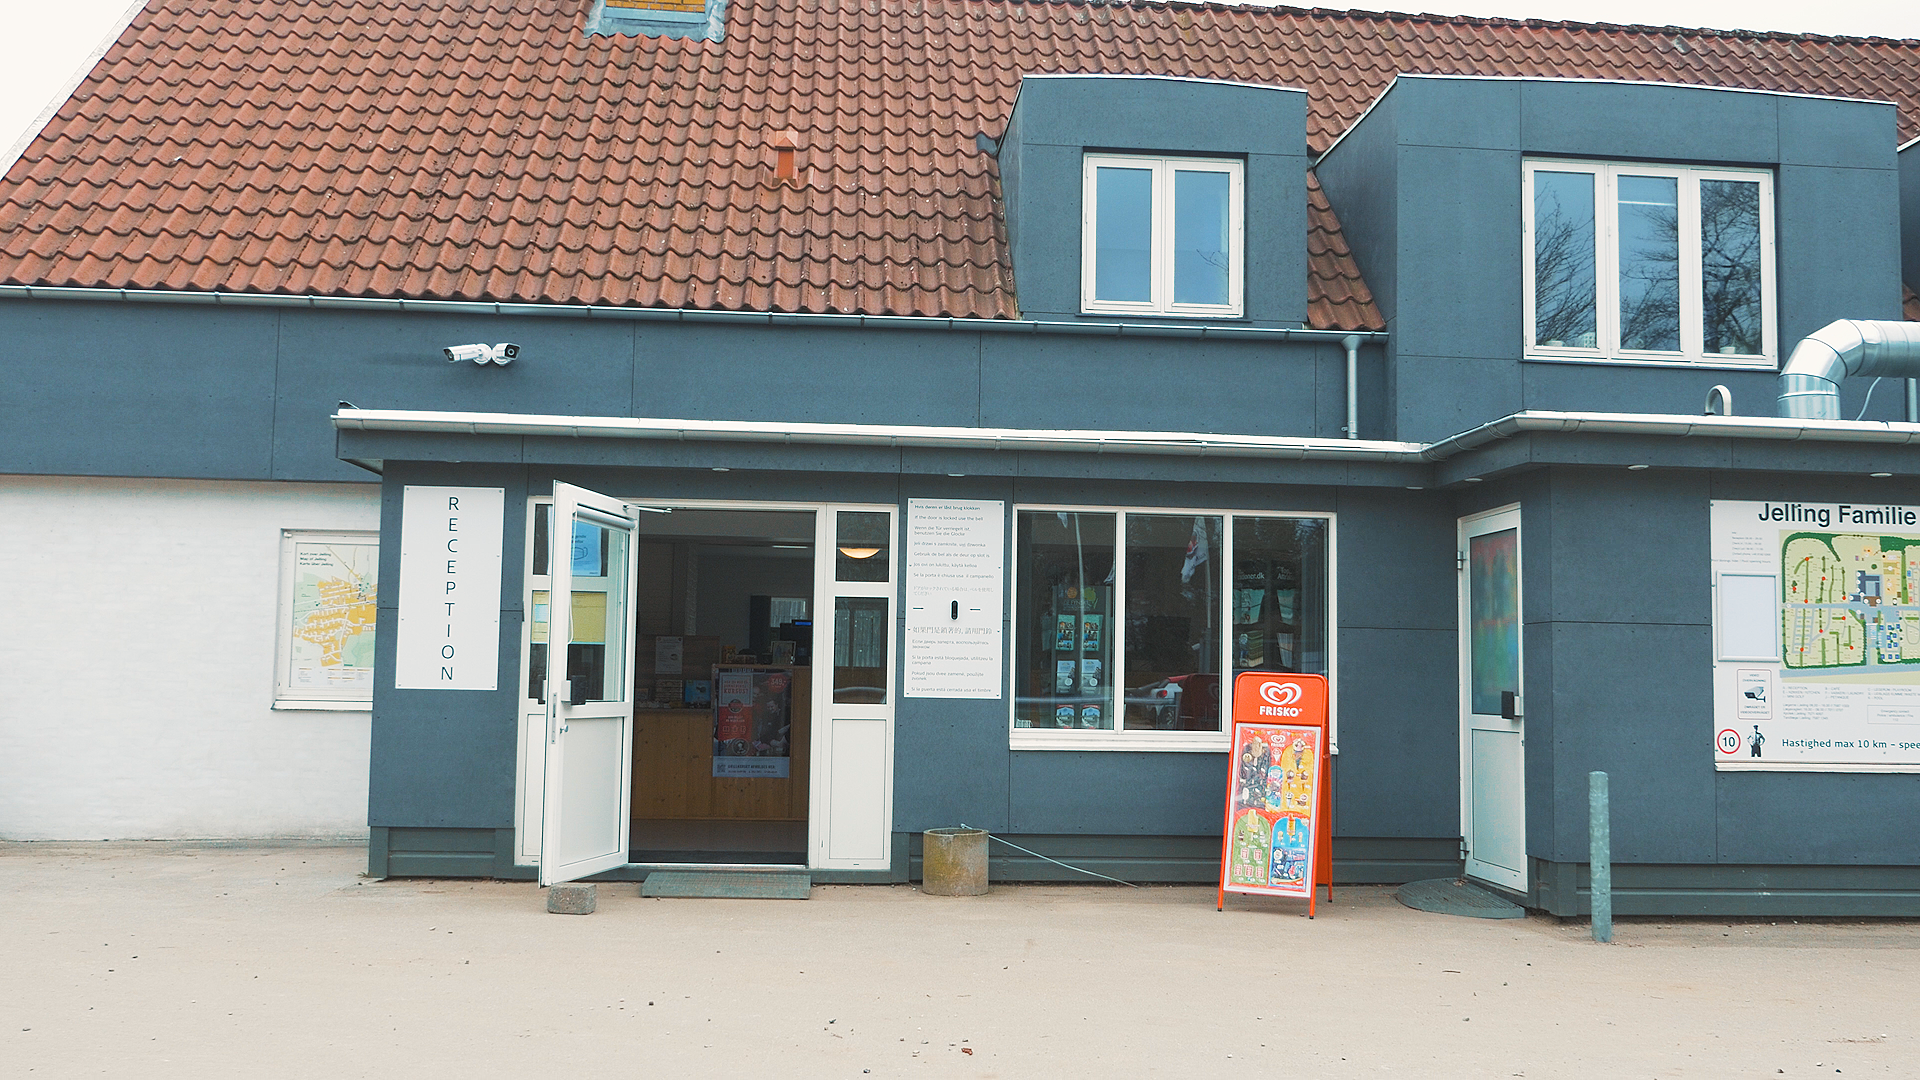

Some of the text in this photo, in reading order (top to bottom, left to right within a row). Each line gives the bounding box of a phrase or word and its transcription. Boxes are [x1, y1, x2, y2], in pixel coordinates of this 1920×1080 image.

[1758, 502, 1916, 528] Jelling Familie
[441, 496, 460, 680] RECEPTION
[1259, 706, 1299, 717] FRISKO
[1722, 737, 1735, 747] 10
[1782, 739, 1831, 750] Hastighed
[1858, 740, 1869, 748] 10
[1872, 739, 1887, 749] km
